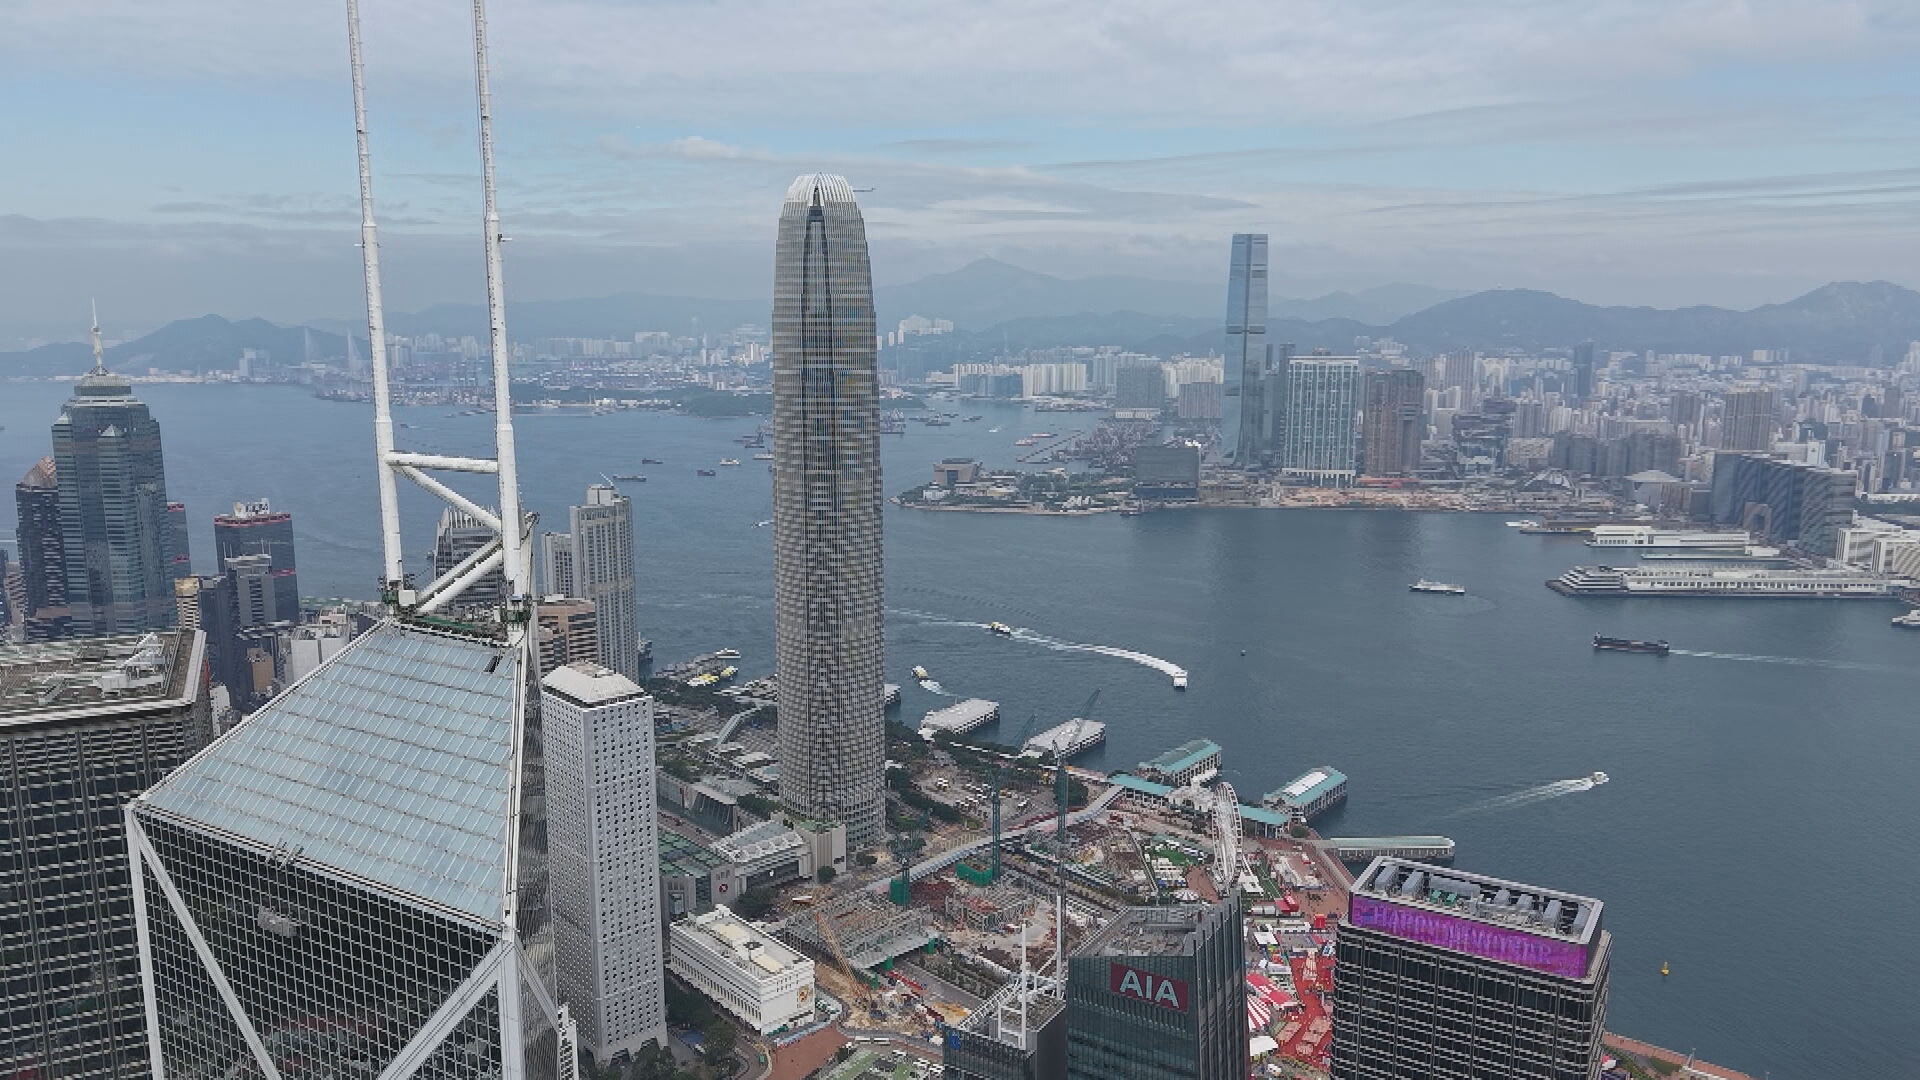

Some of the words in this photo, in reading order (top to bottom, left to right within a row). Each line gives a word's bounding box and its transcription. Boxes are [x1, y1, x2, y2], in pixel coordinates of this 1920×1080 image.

[1373, 904, 1440, 942] HAPPY
[1448, 922, 1490, 955] NEW
[1493, 933, 1552, 966] YEAR
[1120, 970, 1179, 1008] AIA
